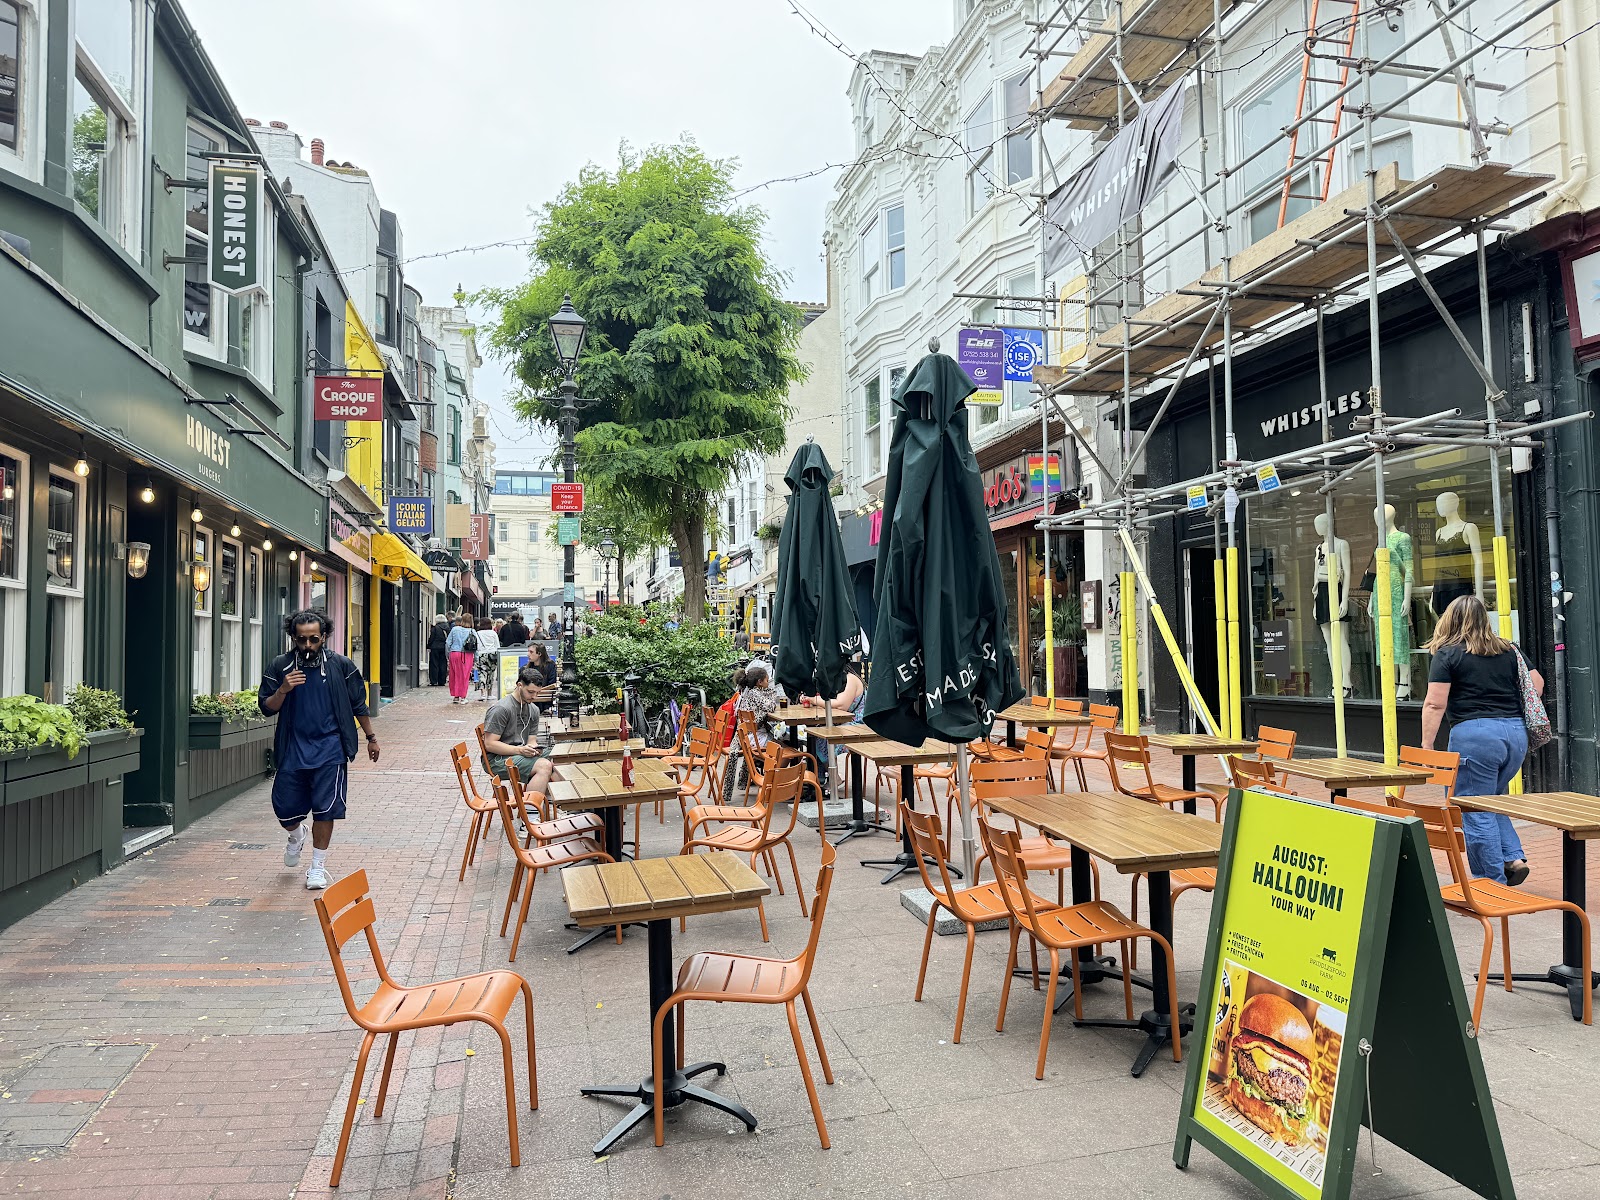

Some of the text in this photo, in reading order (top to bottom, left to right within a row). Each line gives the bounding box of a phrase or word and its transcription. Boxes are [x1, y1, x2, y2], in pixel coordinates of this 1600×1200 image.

[222, 175, 248, 277] HONEST
[1015, 352, 1029, 361] ISE
[340, 381, 356, 389] The
[321, 387, 375, 403] CROQUE
[331, 405, 368, 416] SHOP
[1260, 390, 1362, 438] WHISTLES
[186, 413, 231, 470] HONEST
[199, 462, 221, 484] BURGERS
[396, 503, 425, 511] ICONIC
[396, 511, 425, 519] ITALIAN
[396, 518, 425, 527] GELATO
[926, 662, 977, 709] MADE
[1272, 844, 1328, 876] AUGUST:
[1252, 862, 1344, 912] HALLOUMI
[1270, 894, 1316, 921] YOUR WAY
[1231, 939, 1265, 959] FRIED CHICKEN
[1232, 932, 1262, 948] HONEST BEEF
[1230, 947, 1248, 961] FRITTER
[1319, 970, 1333, 981] FARM
[1308, 982, 1320, 993] AUG
[1325, 990, 1333, 999] 02
[1333, 994, 1348, 1006] SEPT
